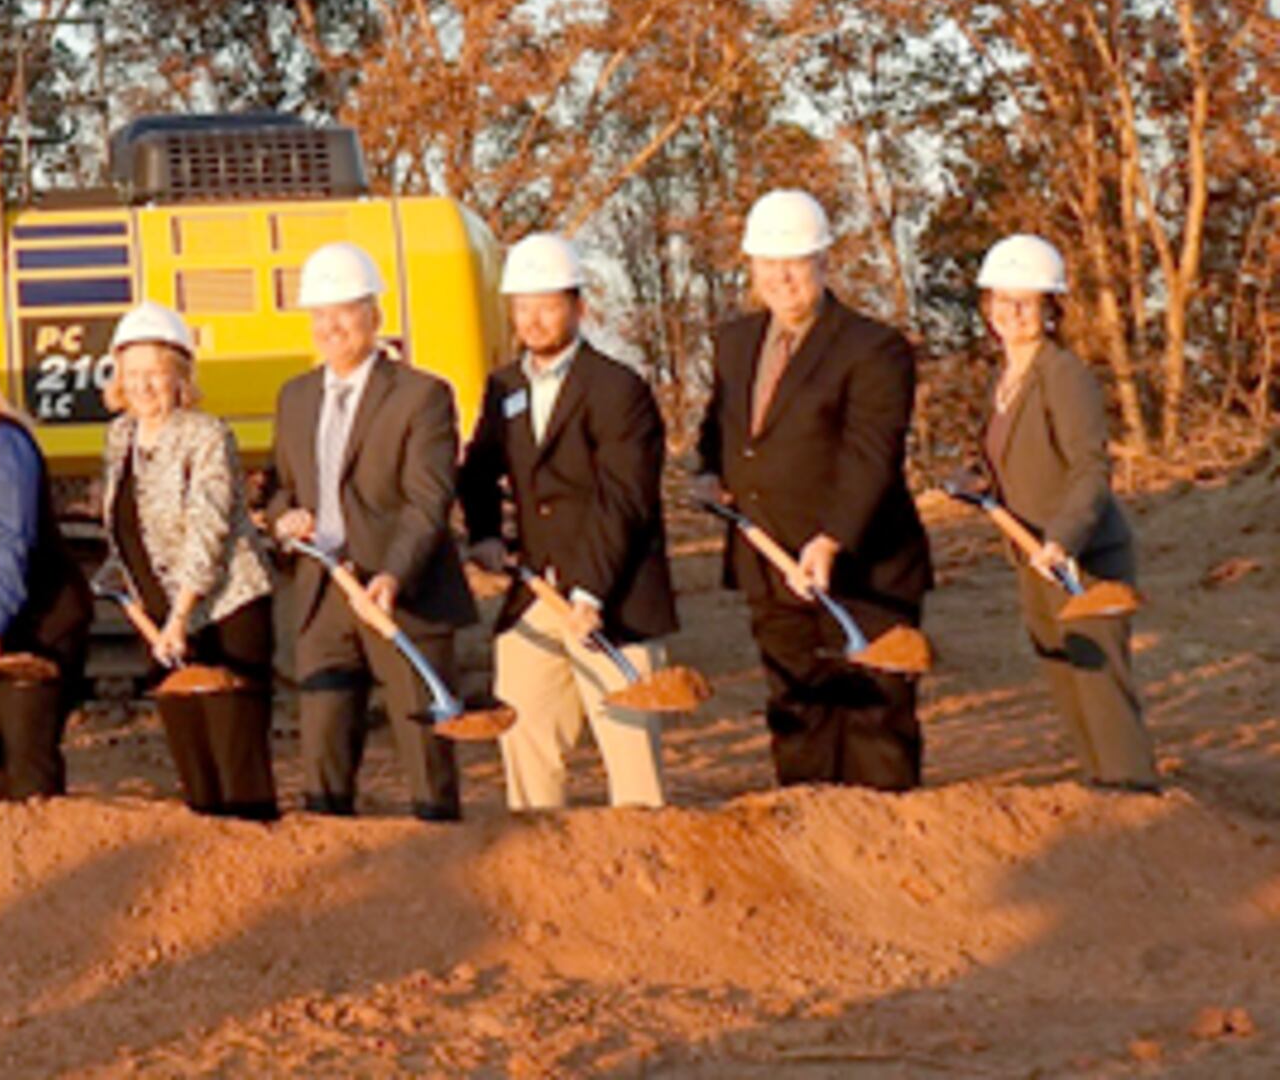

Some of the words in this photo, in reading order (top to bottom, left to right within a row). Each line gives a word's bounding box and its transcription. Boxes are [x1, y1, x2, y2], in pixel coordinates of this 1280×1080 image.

[36, 325, 84, 352] PC
[36, 354, 117, 391] 210
[39, 393, 75, 417] LC
